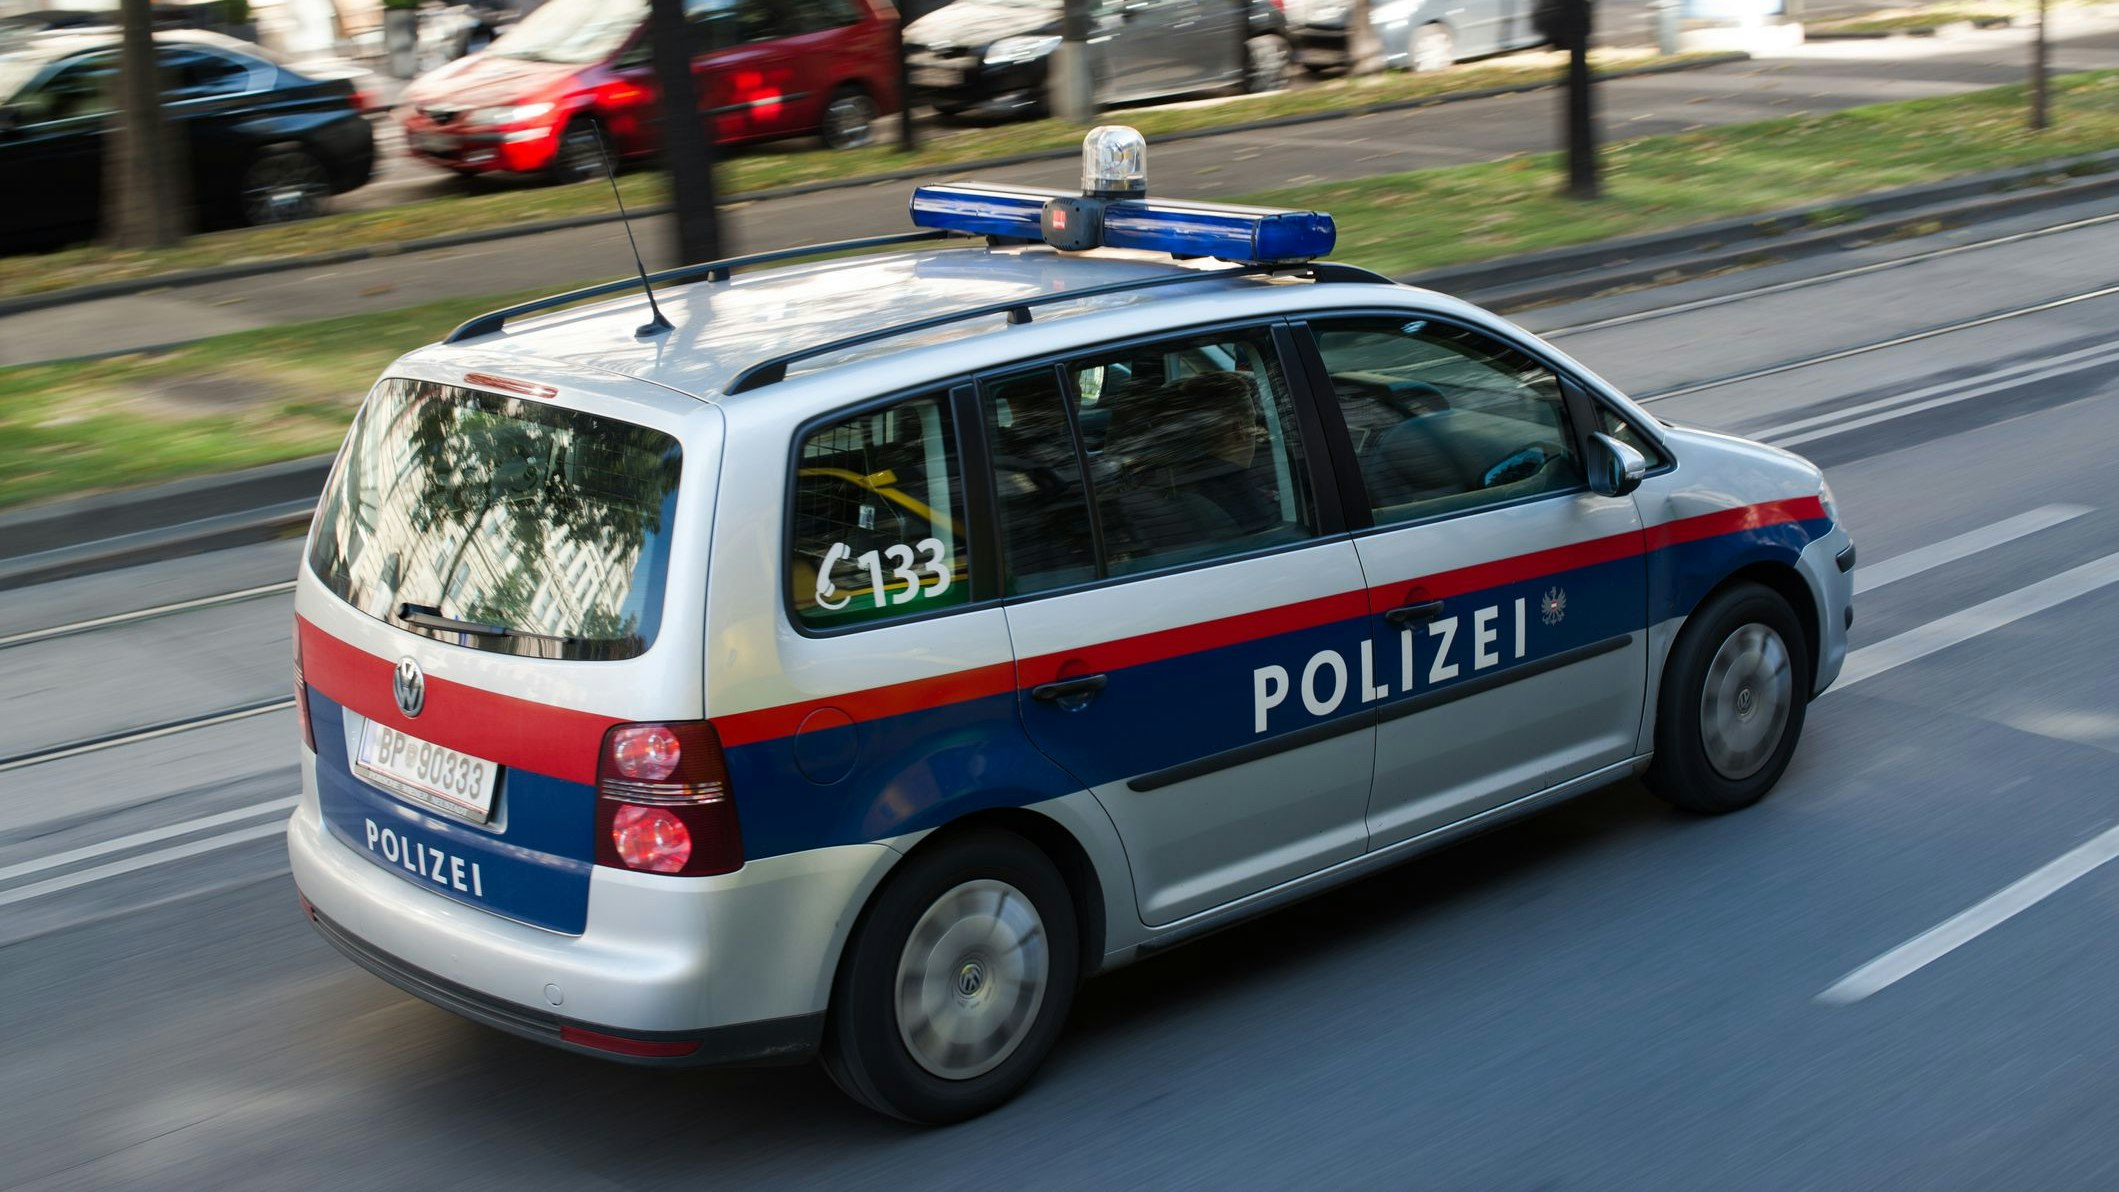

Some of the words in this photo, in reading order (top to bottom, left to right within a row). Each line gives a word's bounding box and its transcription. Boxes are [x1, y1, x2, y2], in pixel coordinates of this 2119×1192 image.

[857, 537, 950, 608] 133
[1253, 597, 1526, 734] POLIZEI
[378, 727, 406, 768] BP
[417, 743, 483, 800] 90333
[365, 817, 483, 897] POLIZEI
